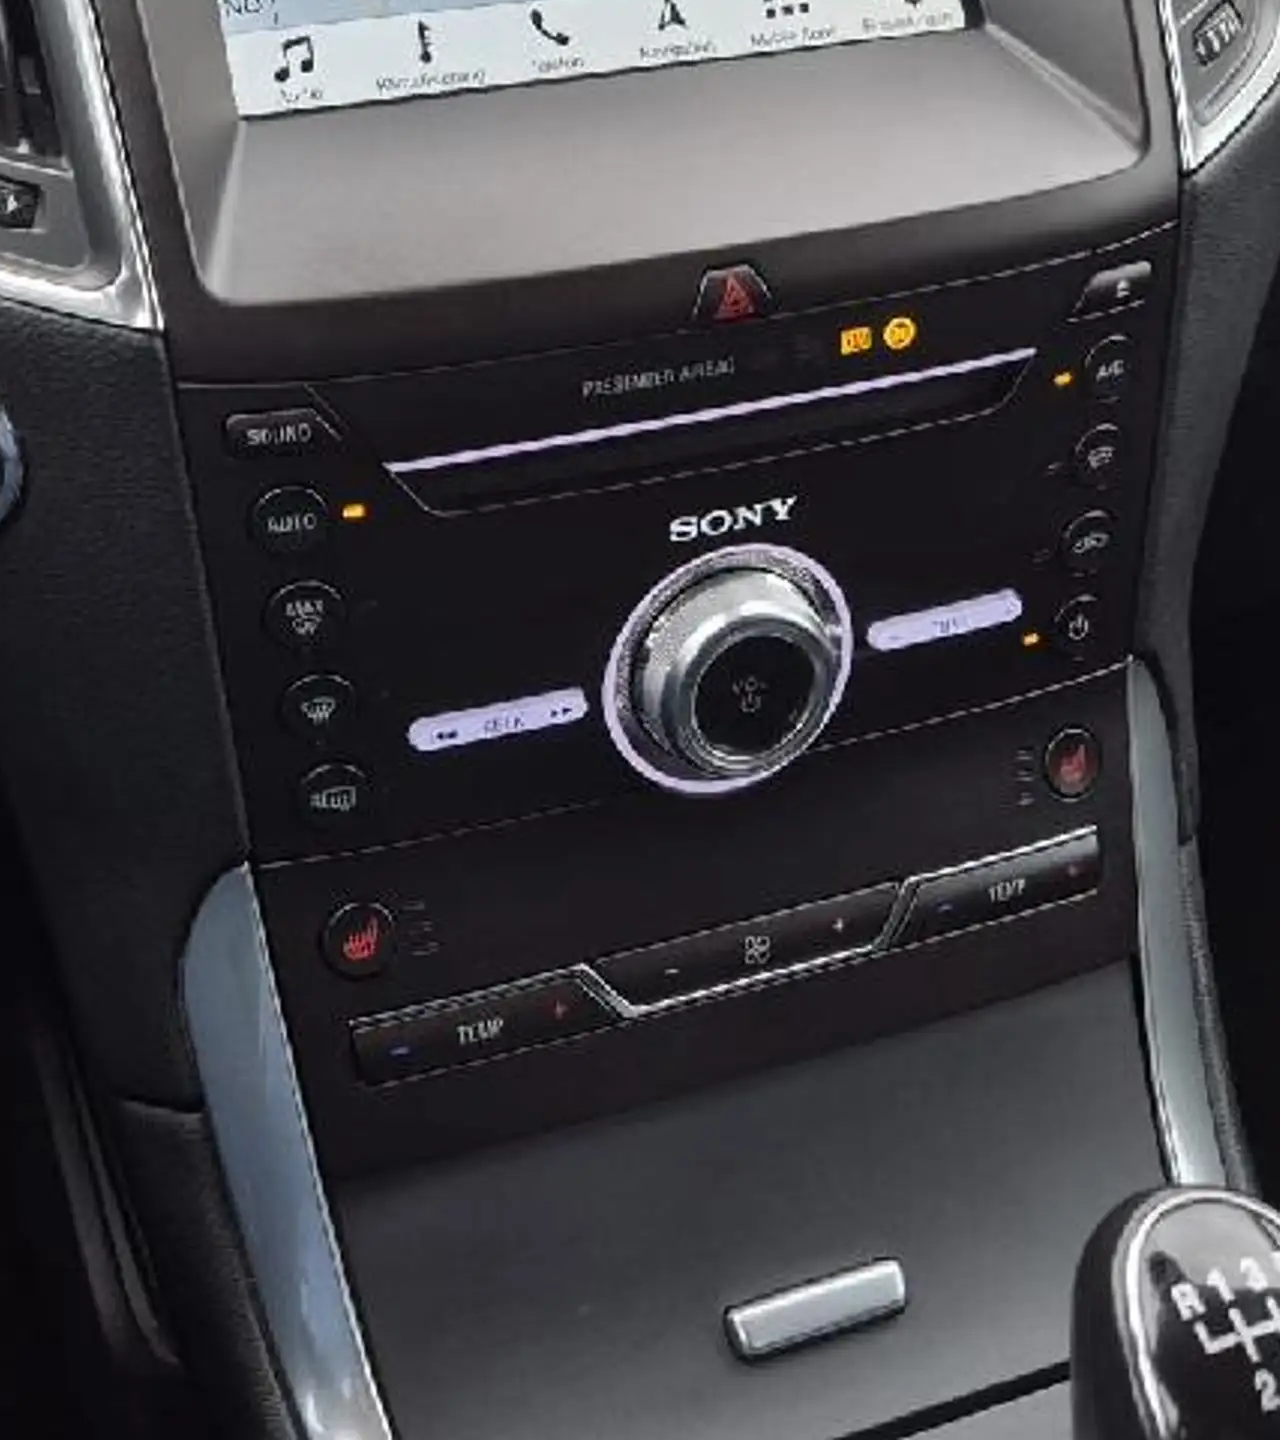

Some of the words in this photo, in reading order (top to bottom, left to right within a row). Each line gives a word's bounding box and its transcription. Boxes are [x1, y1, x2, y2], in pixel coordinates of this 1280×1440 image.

[246, 421, 313, 446] SOUND
[268, 512, 318, 533] AUTO
[669, 495, 798, 542] SONY
[1170, 1282, 1206, 1321] R
[1206, 1267, 1236, 1303] 1
[1240, 1256, 1269, 1292] 3
